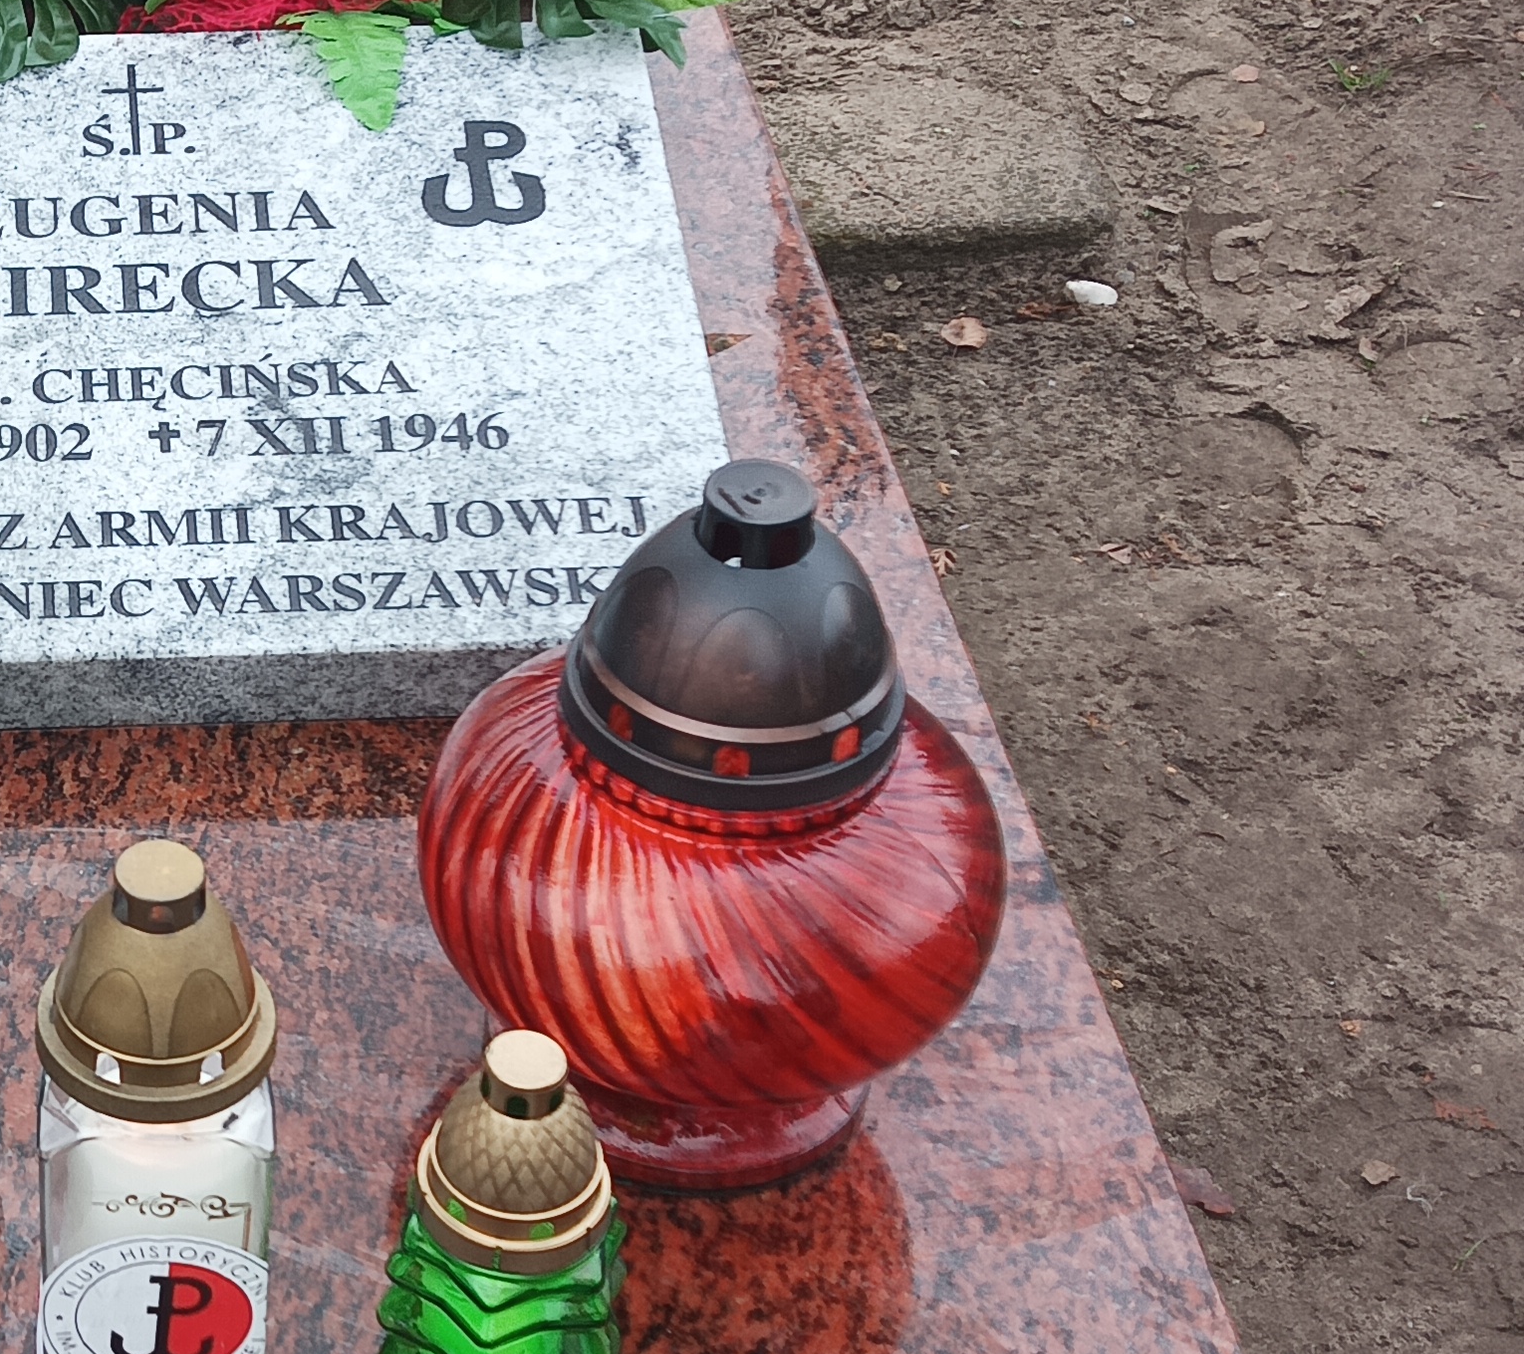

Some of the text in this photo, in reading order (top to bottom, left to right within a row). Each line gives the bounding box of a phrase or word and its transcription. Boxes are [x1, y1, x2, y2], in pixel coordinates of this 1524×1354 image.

[82, 115, 196, 157] Ś. P.
[33, 353, 418, 411] CHĘCIŃSKA
[244, 416, 352, 457] XII
[373, 411, 510, 454] 1946
[48, 507, 256, 549] ARMII
[273, 497, 650, 543] KRAJOWEJ
[173, 566, 623, 617] WARSZAWSK
[60, 1245, 267, 1306] KLUB HISTORYCZN
